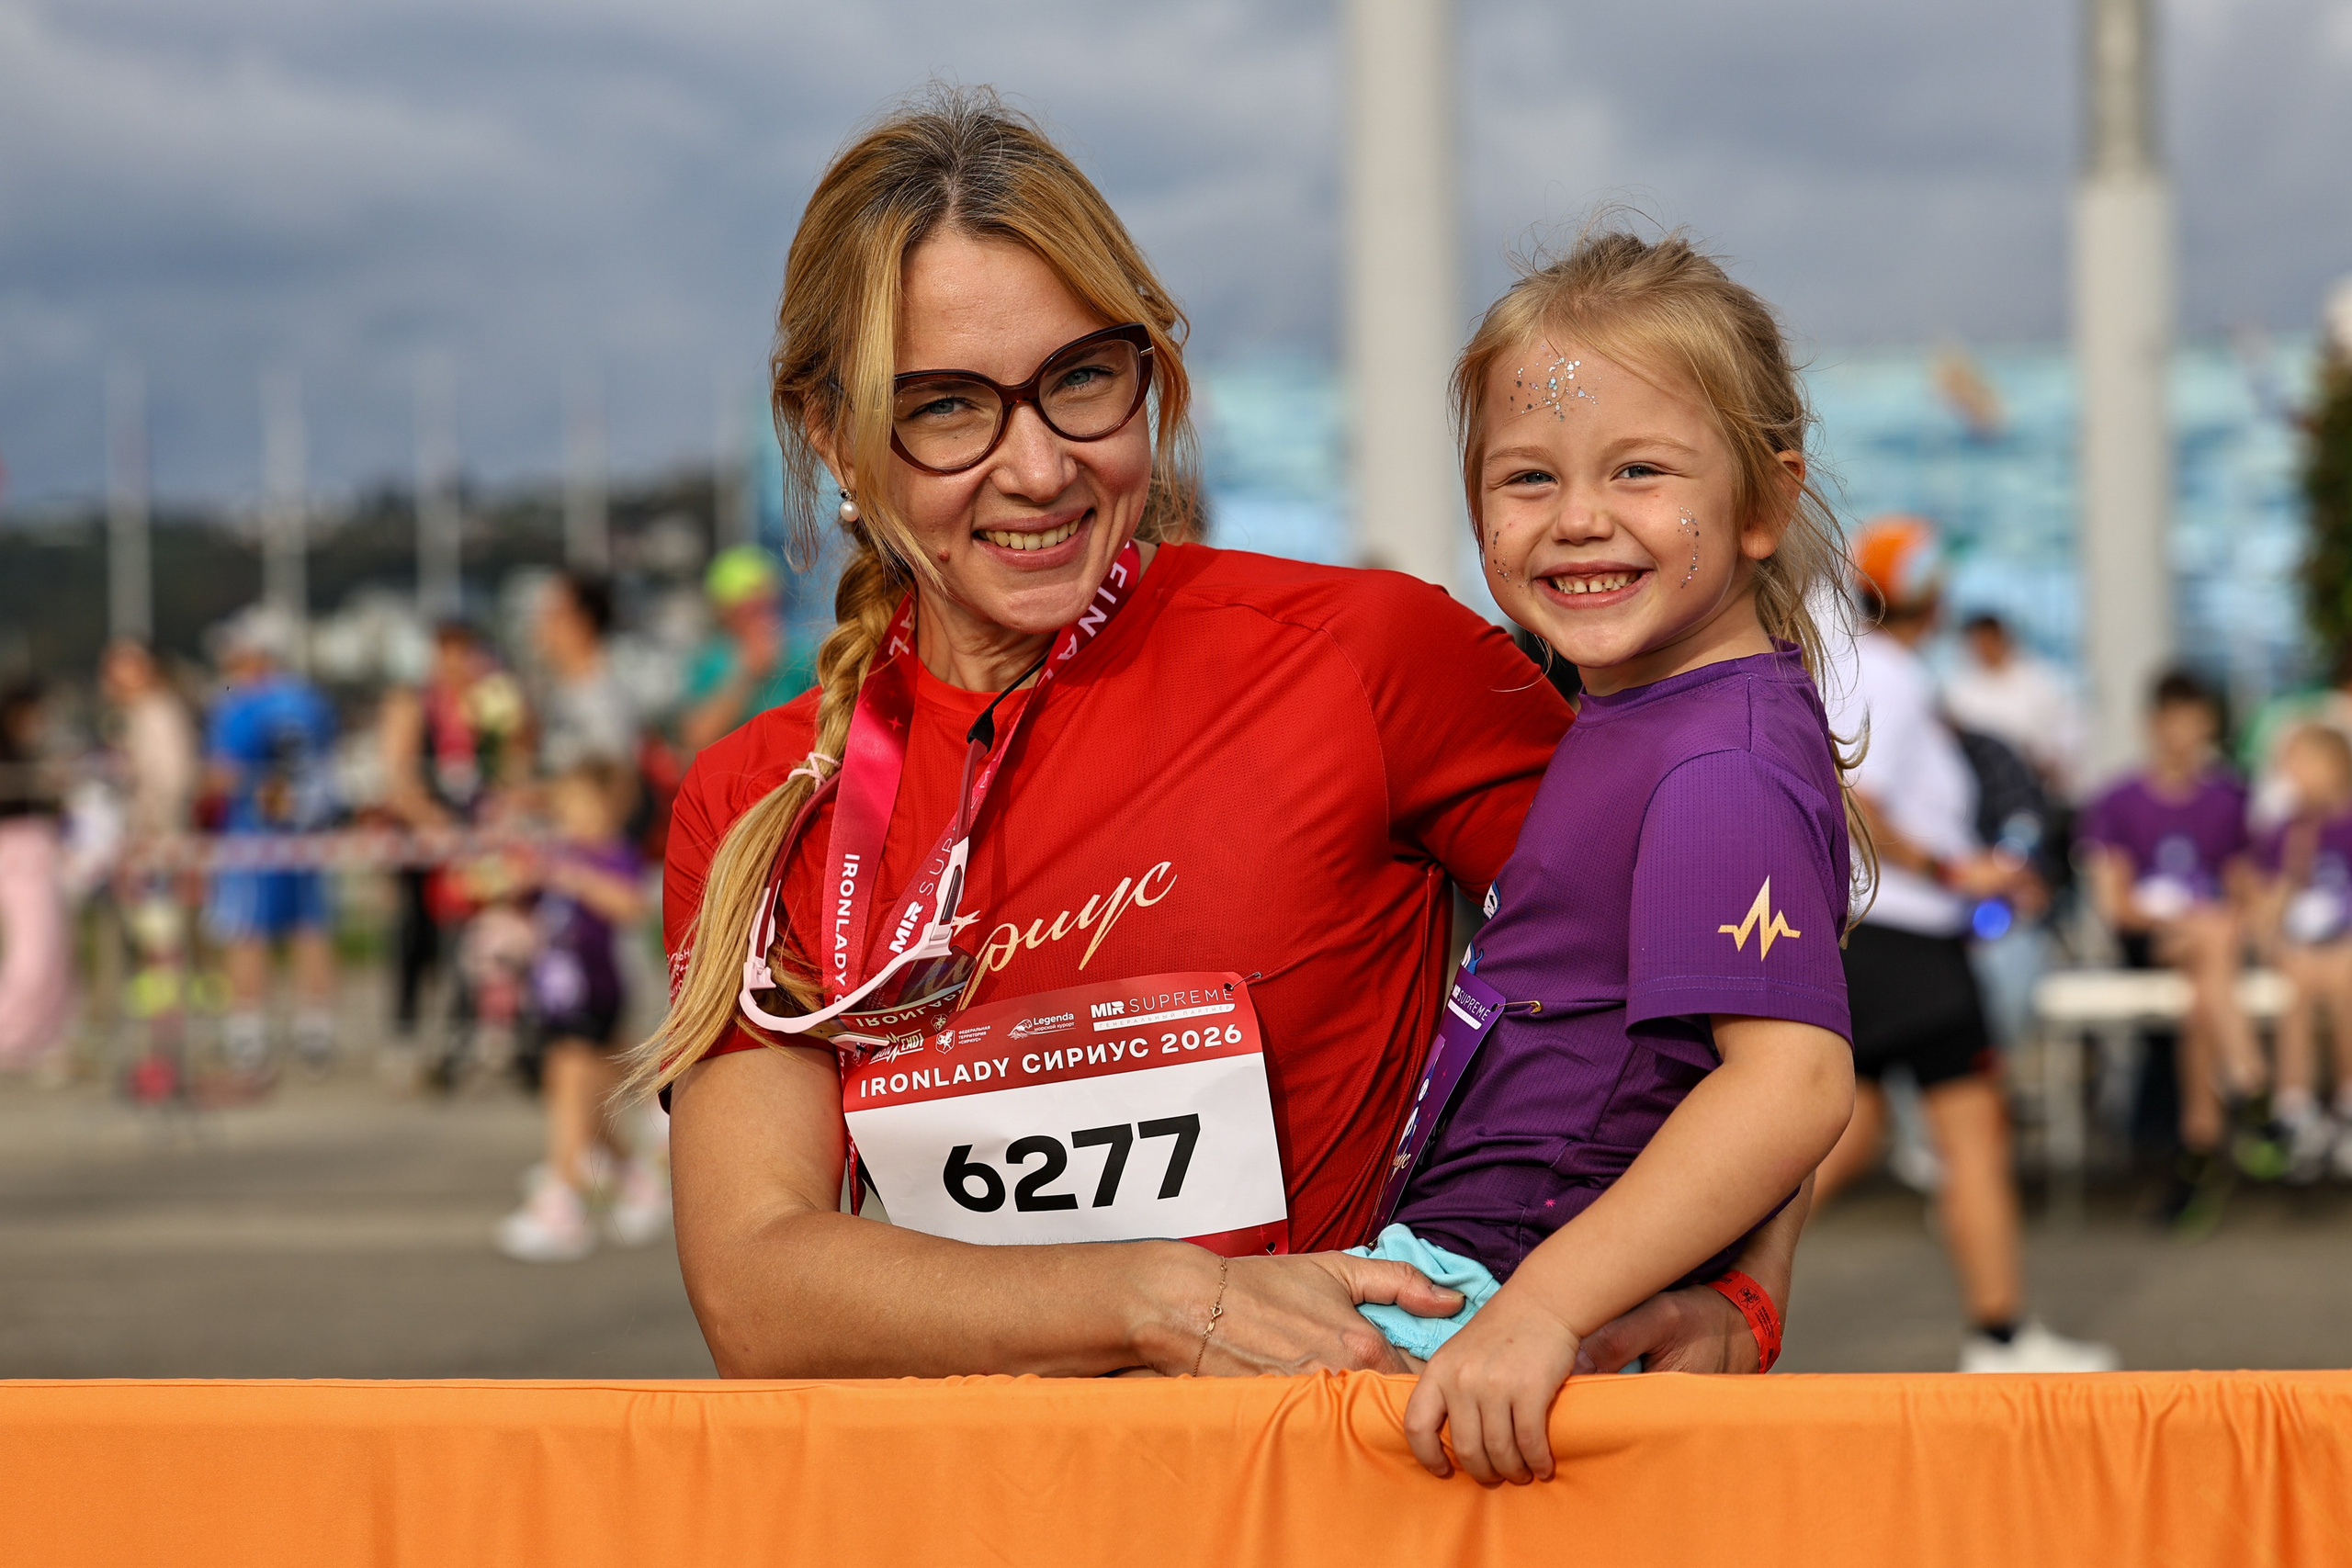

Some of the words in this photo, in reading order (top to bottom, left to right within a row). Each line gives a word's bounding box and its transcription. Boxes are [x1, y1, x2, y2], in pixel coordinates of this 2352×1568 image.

[833, 853, 861, 987] IRONLADY
[888, 900, 924, 954] MIR
[1033, 1011, 1075, 1027] Legenda
[1090, 1000, 1125, 1019] MIR
[1129, 988, 1235, 1013] SUPREME
[1457, 989, 1491, 1021] SUPREME
[958, 1031, 987, 1040] ТЕРРИТОРИЯ
[859, 1056, 1009, 1099] IRONLADY
[1022, 1037, 1149, 1075] СИРИУС
[1160, 1023, 1242, 1054] 2026
[943, 1112, 1201, 1213] 6277
